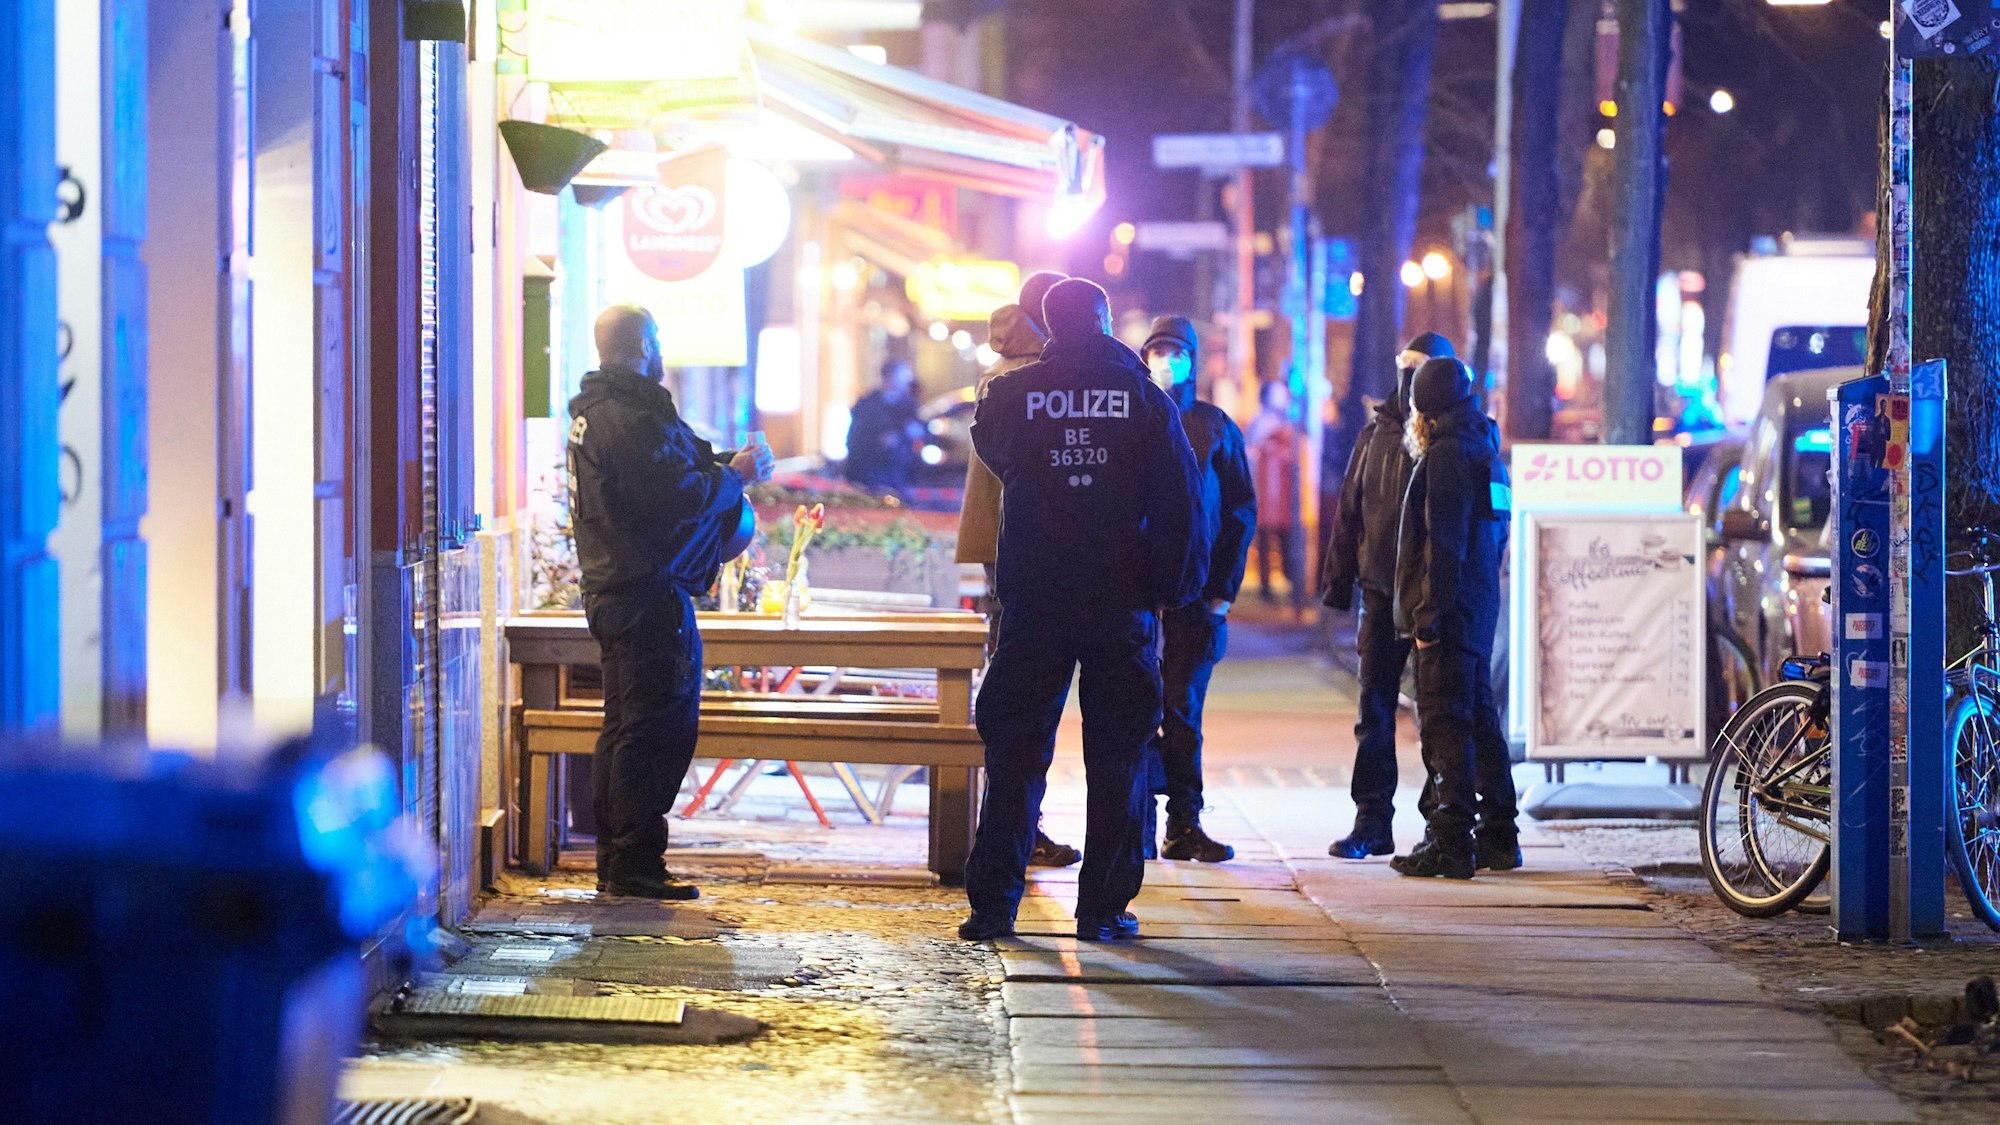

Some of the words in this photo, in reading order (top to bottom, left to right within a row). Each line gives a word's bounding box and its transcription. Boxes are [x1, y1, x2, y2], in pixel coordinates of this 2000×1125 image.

[1026, 389, 1130, 420] POLIZEI
[1065, 428, 1091, 445] BE
[1050, 448, 1108, 467] 36320
[1566, 456, 1664, 482] LOTTO
